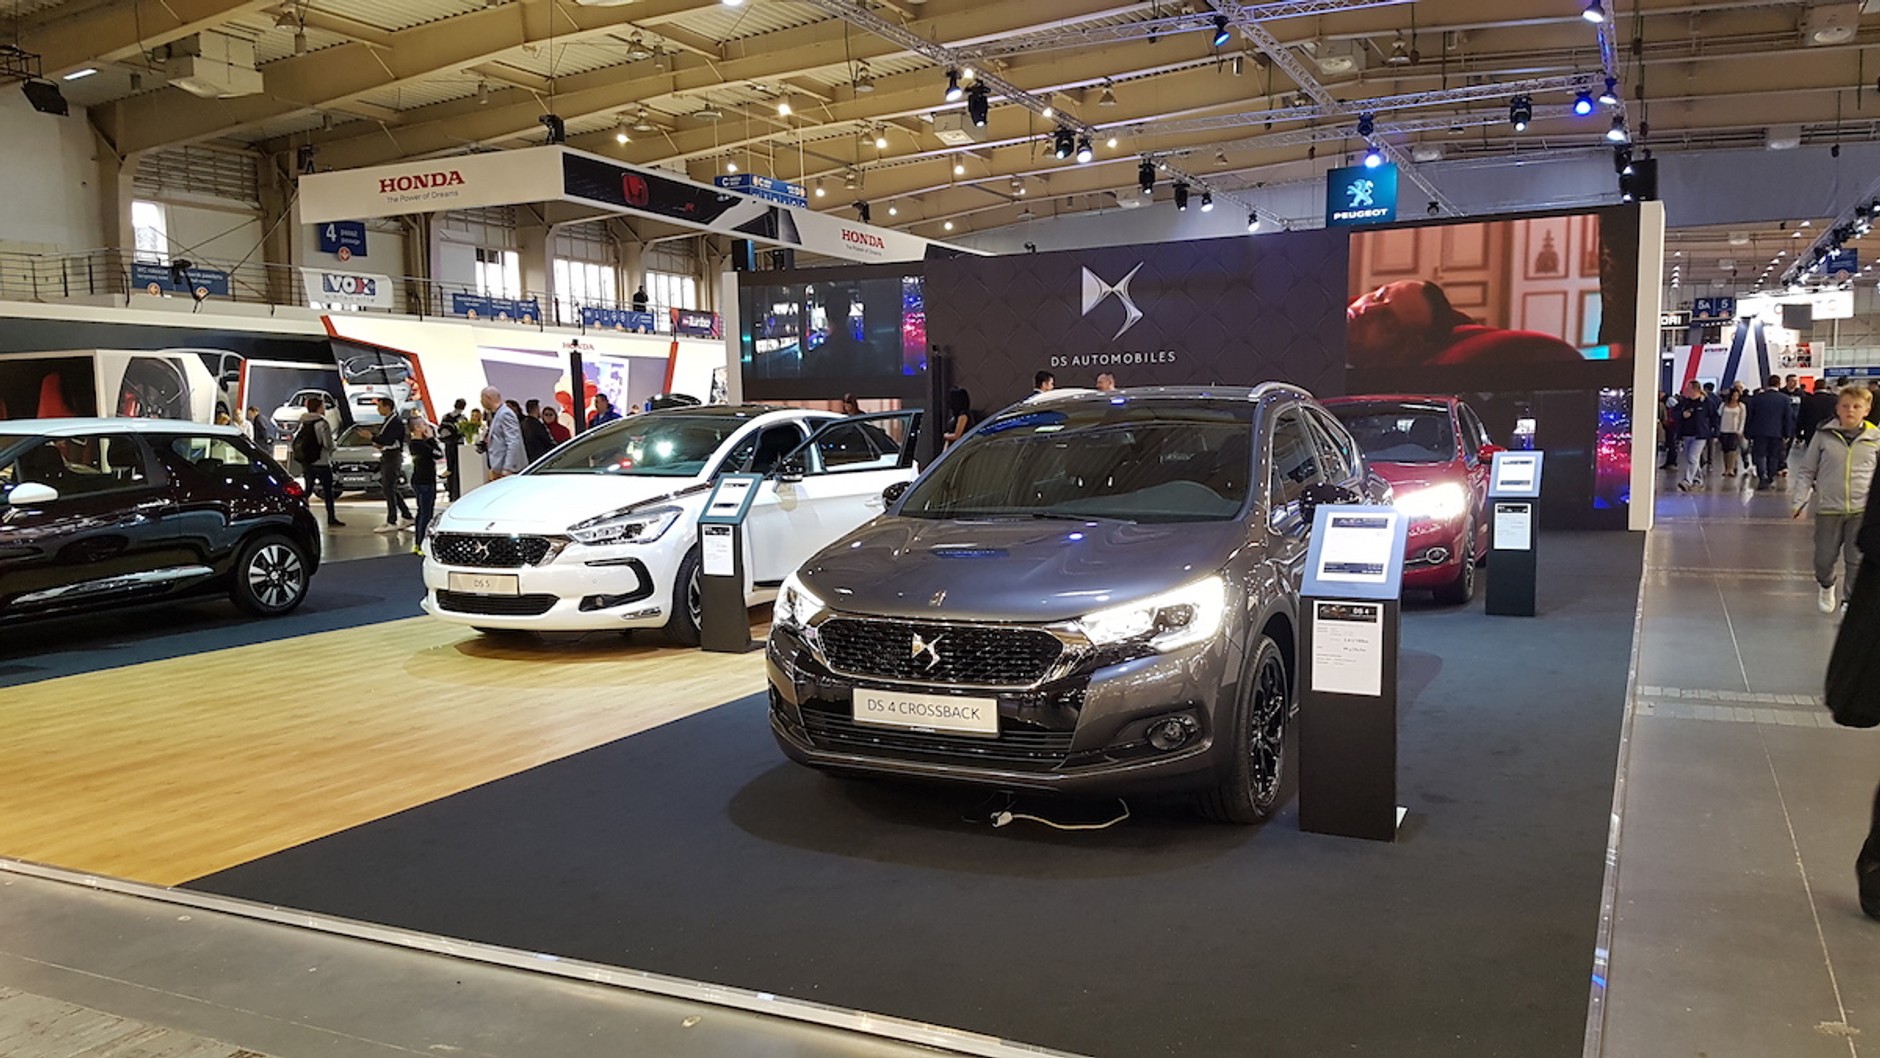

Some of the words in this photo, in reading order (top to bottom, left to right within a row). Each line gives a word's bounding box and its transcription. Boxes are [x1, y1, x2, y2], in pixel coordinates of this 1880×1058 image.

[378, 170, 466, 194] HONDA
[387, 195, 399, 203] The
[400, 193, 420, 203] Power
[422, 191, 430, 201] of
[431, 189, 459, 200] Dreams
[1333, 208, 1389, 221] PEUGEOT
[325, 223, 337, 242] 4
[841, 229, 885, 249] HONDA
[1698, 300, 1711, 310] 5A
[1051, 355, 1068, 367] DS
[1071, 351, 1177, 366] AUTOMOBILES
[867, 698, 885, 712] DS
[888, 701, 896, 713] 4
[899, 702, 981, 721] CROSSBACK
